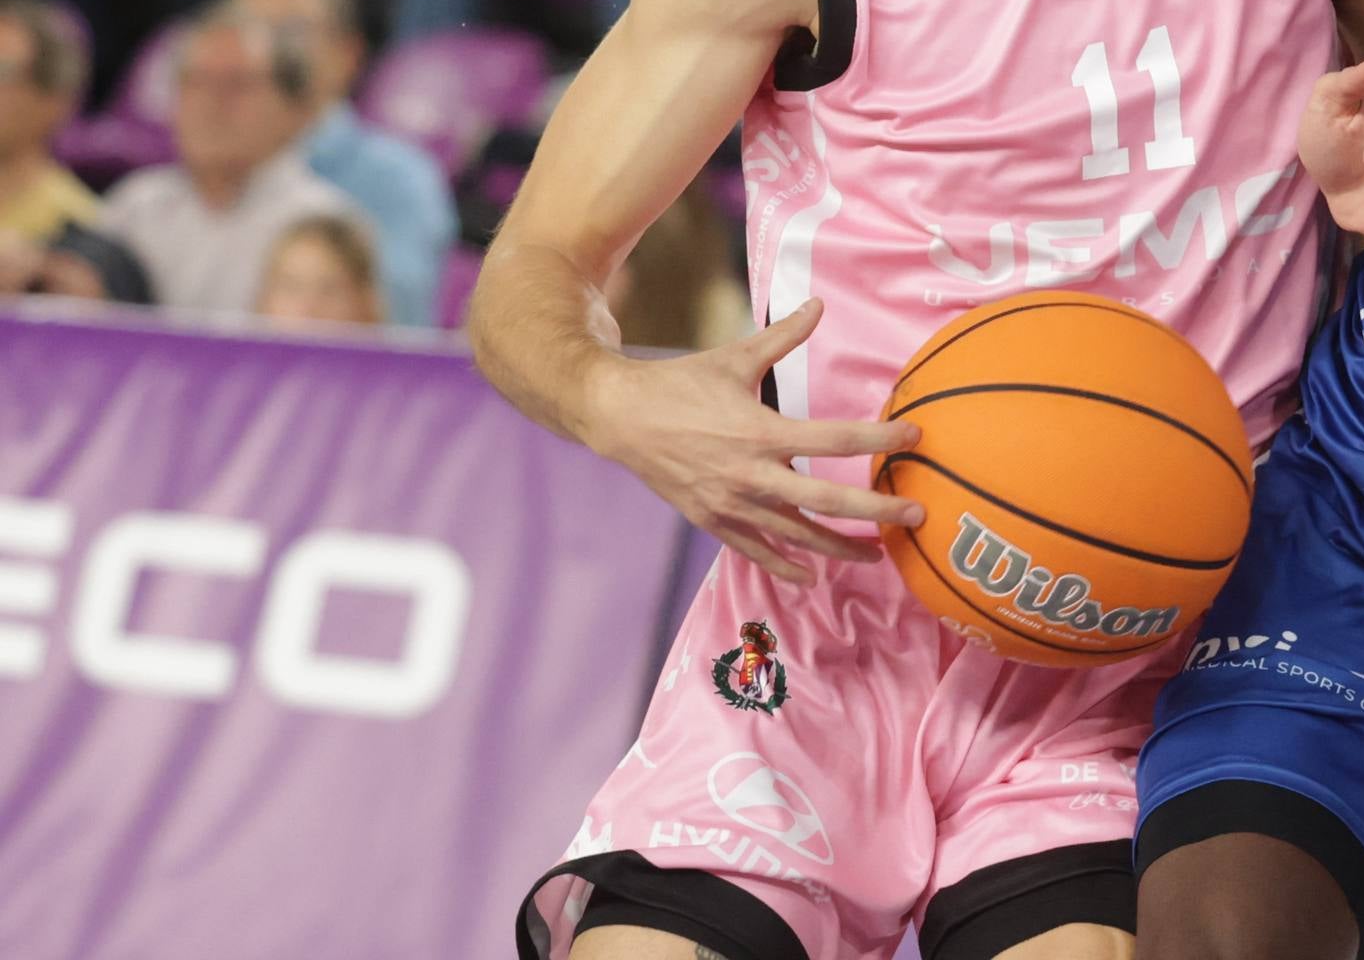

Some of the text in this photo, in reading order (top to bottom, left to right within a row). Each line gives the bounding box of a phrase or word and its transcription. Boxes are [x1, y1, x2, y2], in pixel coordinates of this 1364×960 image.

[1071, 25, 1196, 180] 11
[927, 157, 1299, 287] UEMC
[949, 512, 1181, 637] Wilson
[1276, 661, 1356, 702] SPORTS
[1060, 762, 1100, 784] DE
